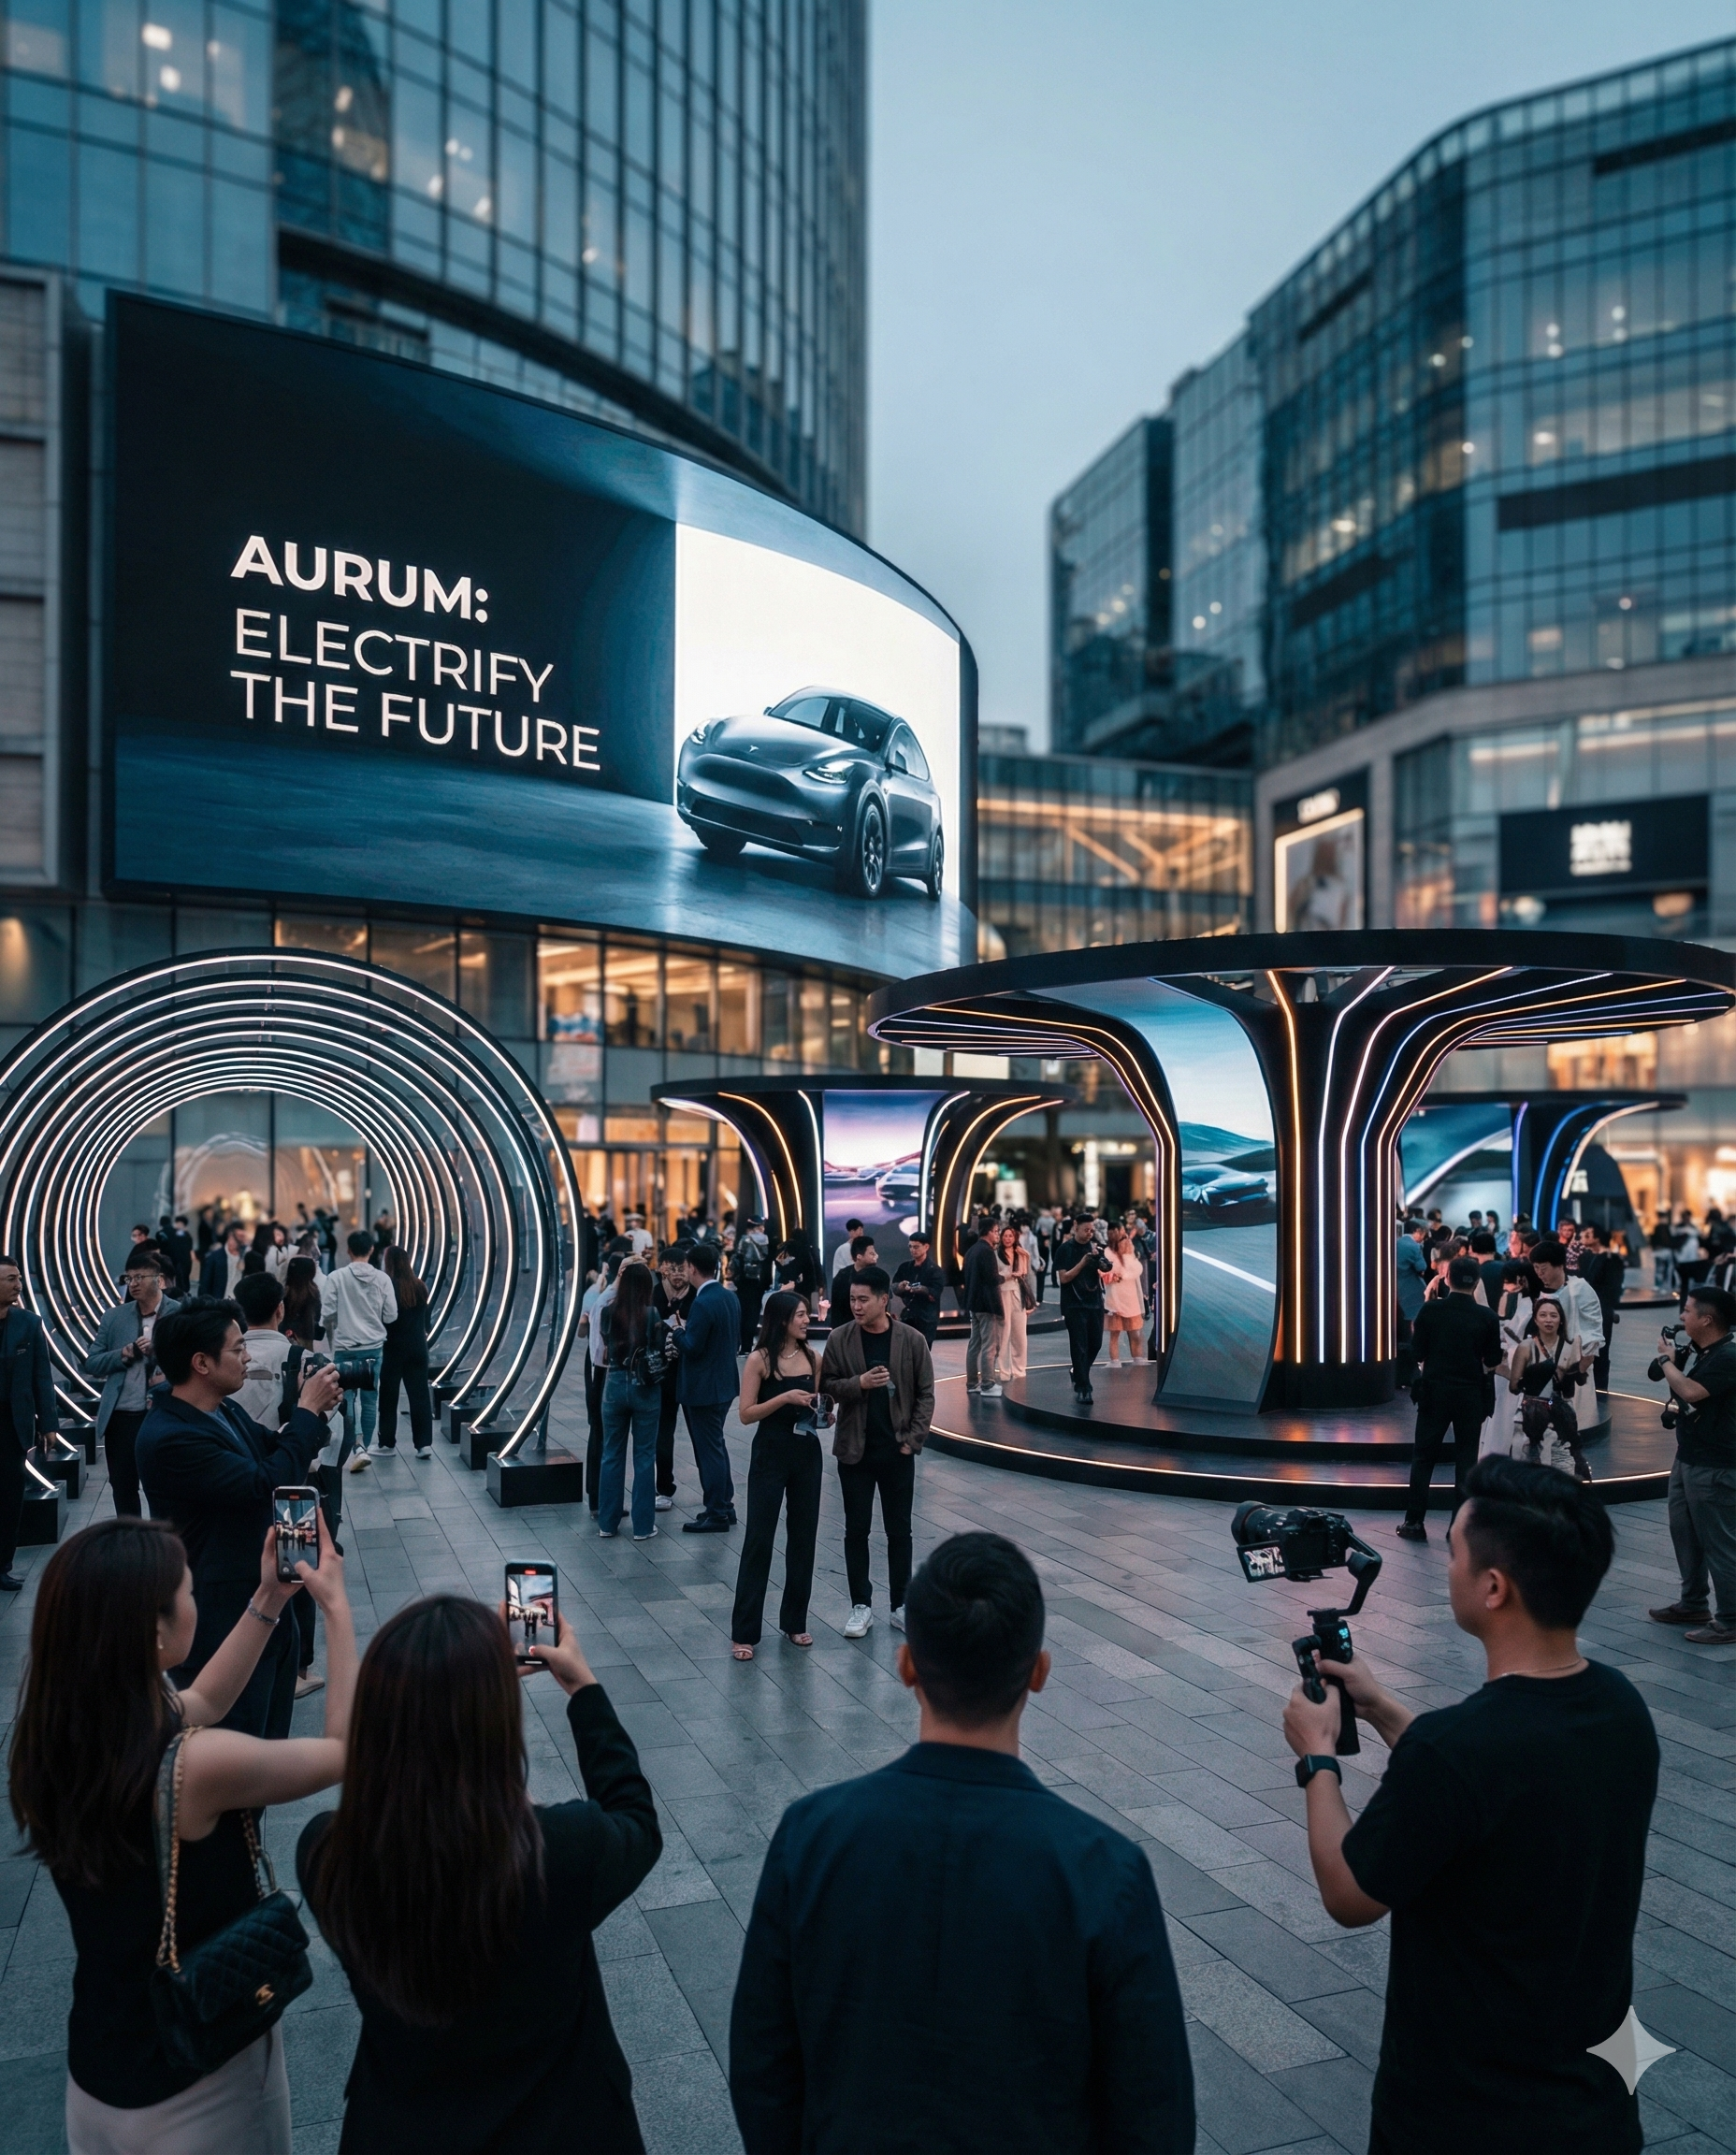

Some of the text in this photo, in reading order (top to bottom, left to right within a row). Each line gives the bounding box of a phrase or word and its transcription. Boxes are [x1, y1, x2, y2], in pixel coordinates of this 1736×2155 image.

[230, 535, 489, 624] AURUM:
[236, 608, 555, 703] ELECTRIFY
[230, 670, 600, 771] THE FUTURE
